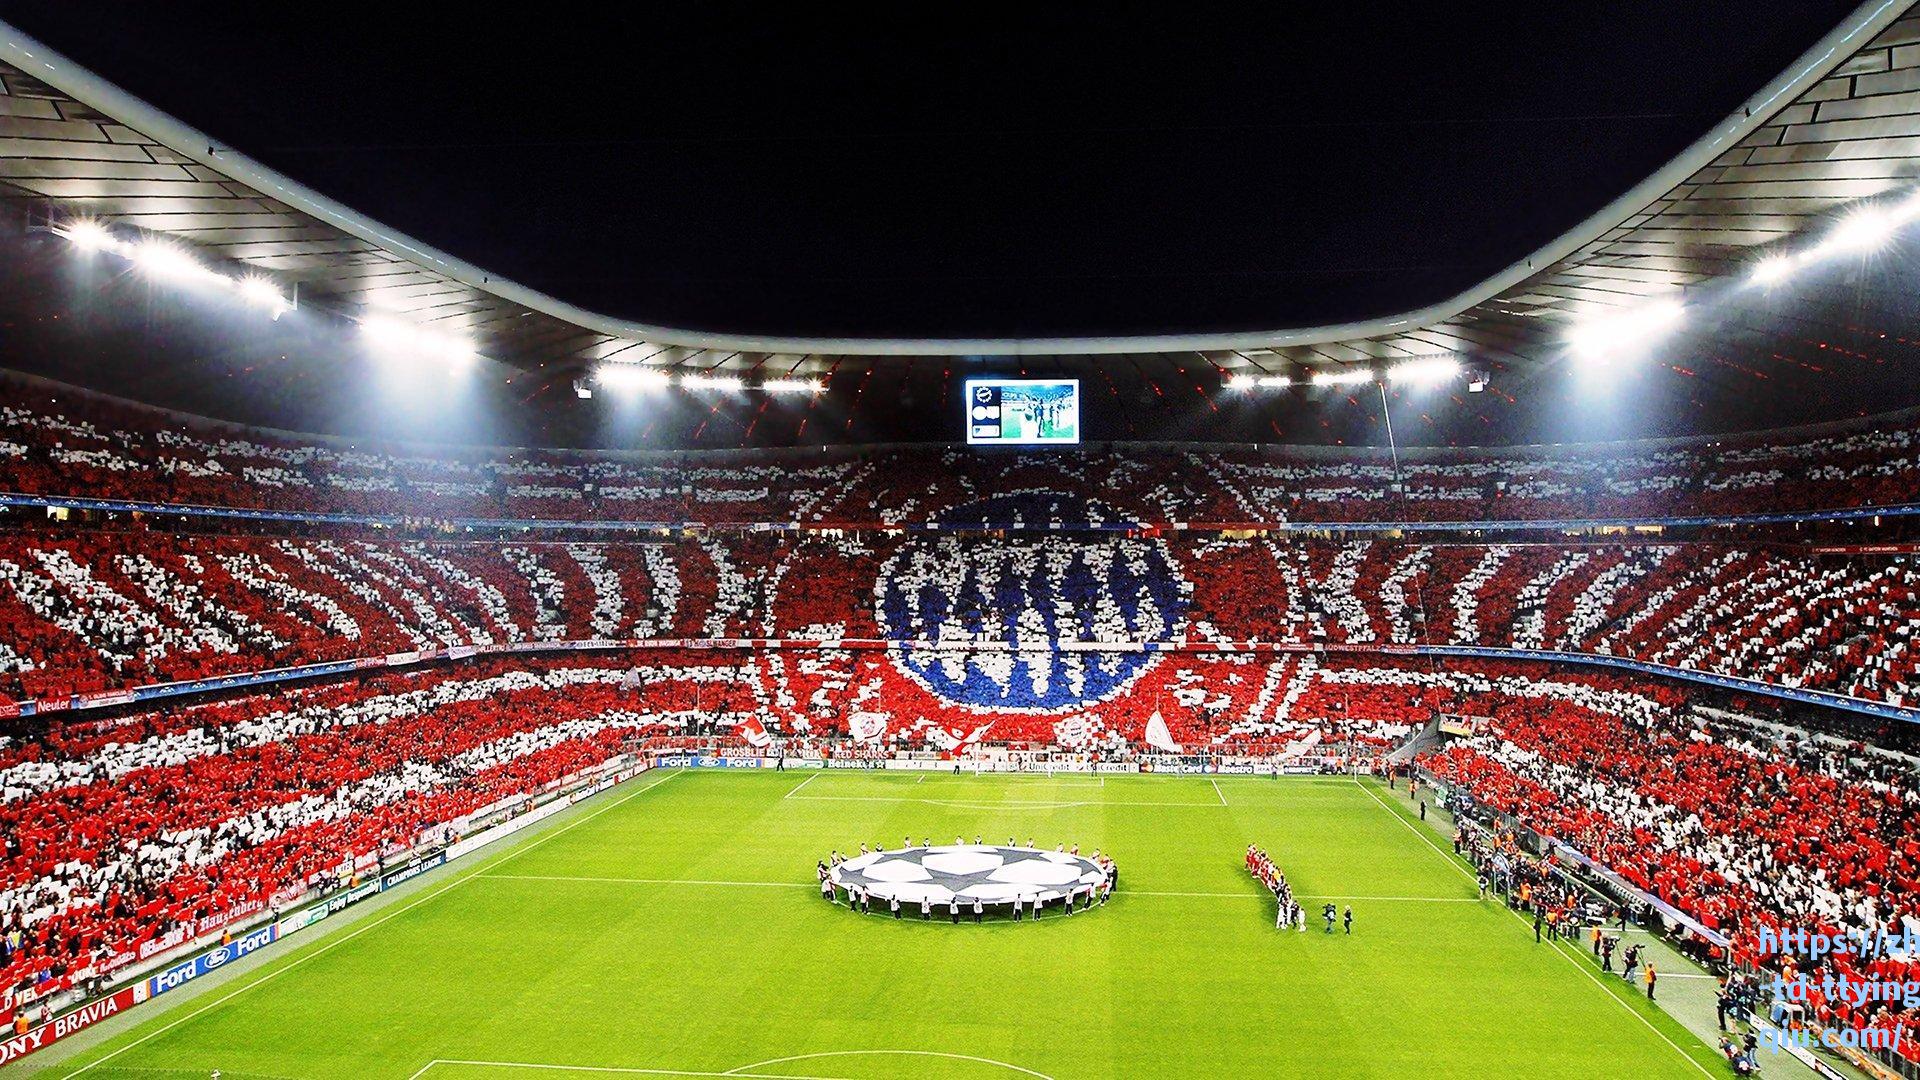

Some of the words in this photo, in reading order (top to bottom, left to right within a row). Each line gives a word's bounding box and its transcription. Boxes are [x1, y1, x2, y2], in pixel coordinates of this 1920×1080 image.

[37, 699, 70, 713] Neuler
[660, 756, 692, 767] Ford
[726, 757, 757, 768] Ford
[386, 863, 421, 888] CHAMPIONS
[421, 854, 443, 873] LEAGUE
[329, 894, 347, 912] Enjoy
[347, 879, 380, 904] Responsibly
[199, 900, 264, 932] Hauzenberg
[235, 926, 271, 956] Ford
[155, 958, 197, 993] Ford
[55, 997, 118, 1039] BRAVIA
